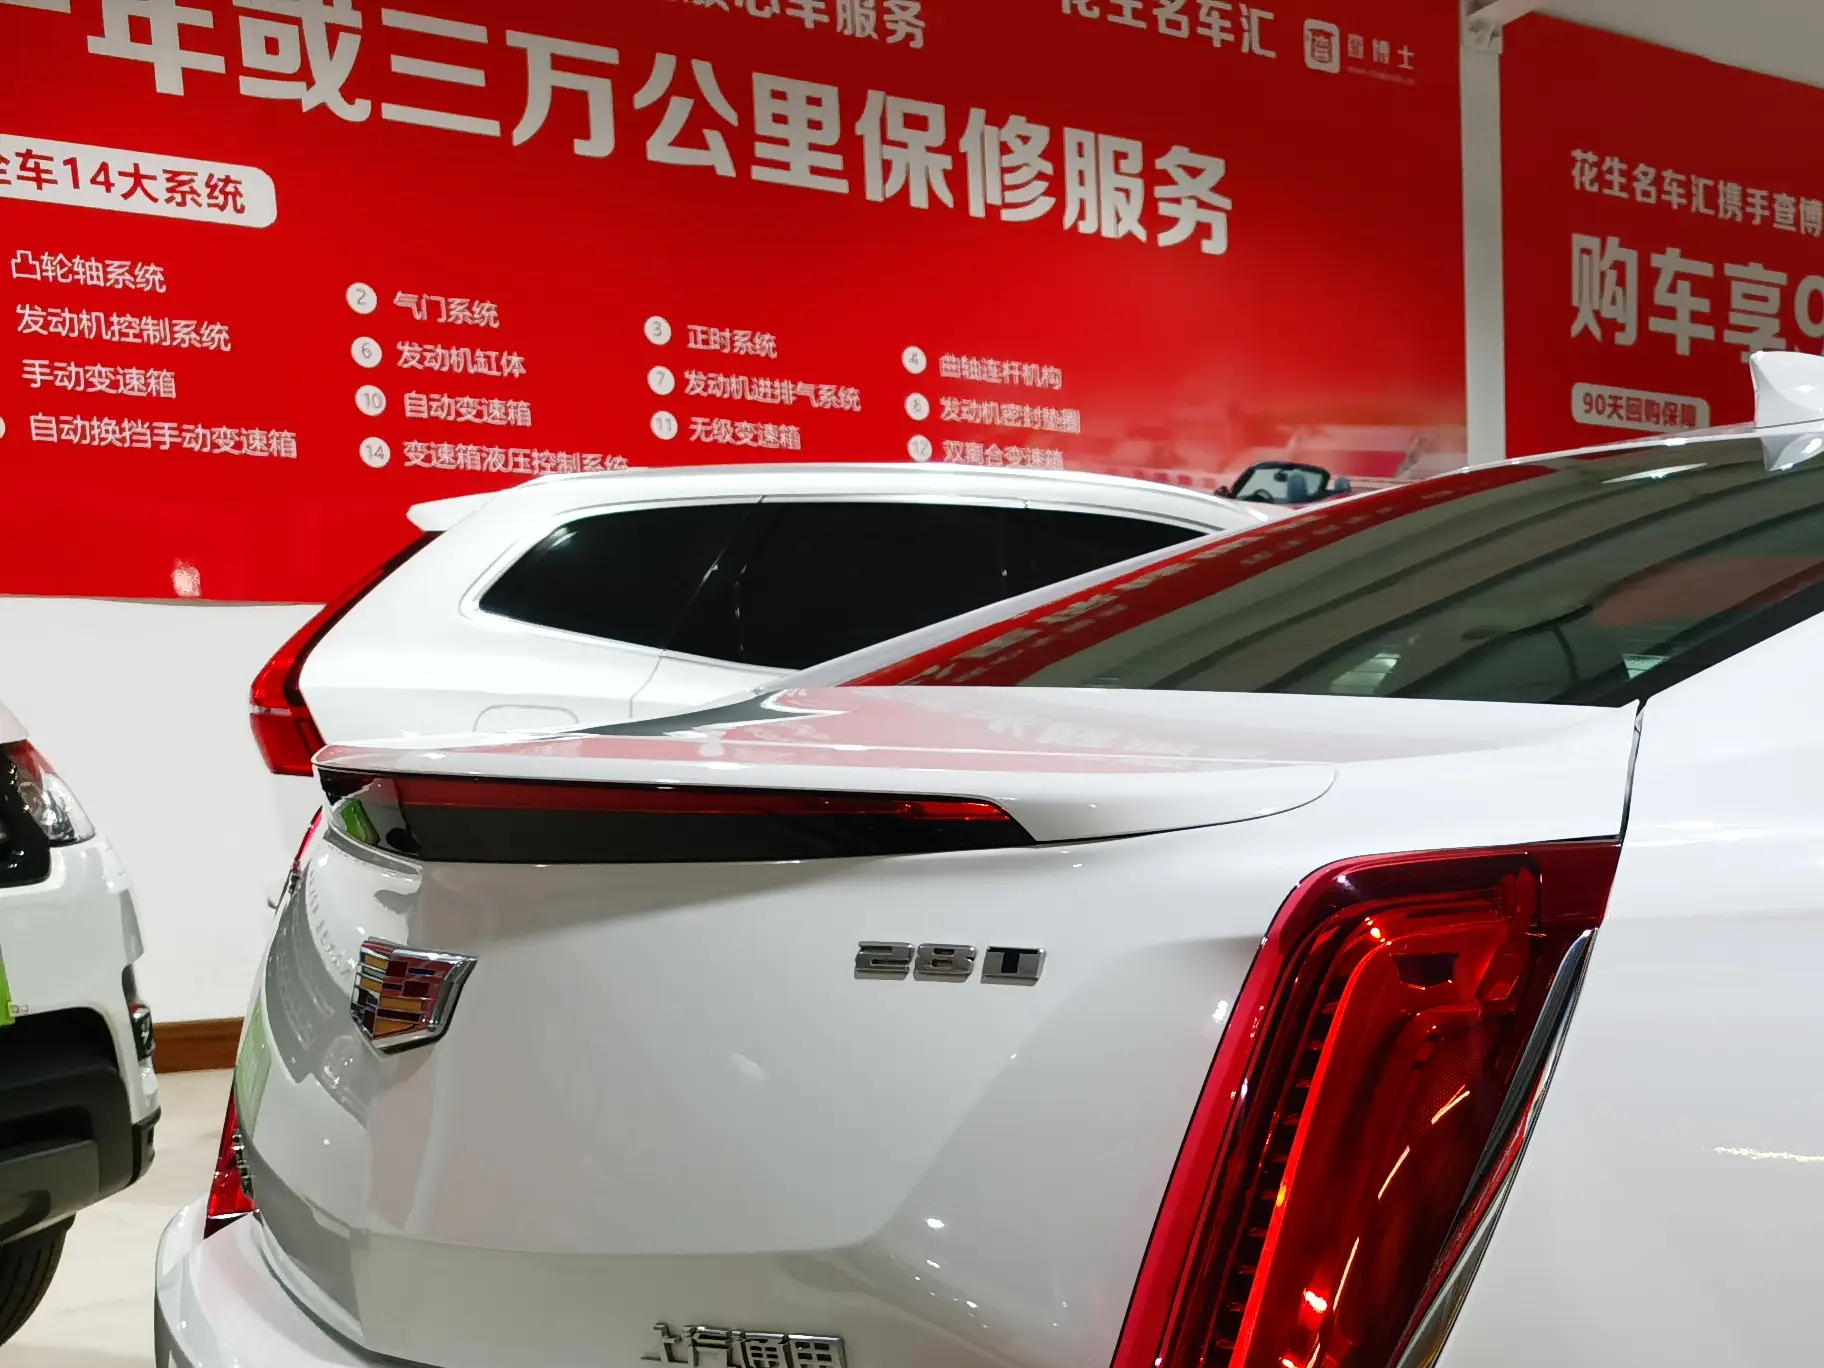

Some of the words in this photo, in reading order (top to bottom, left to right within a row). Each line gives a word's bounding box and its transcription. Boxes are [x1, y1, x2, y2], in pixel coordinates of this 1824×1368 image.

[11, 249, 167, 293] 凸轮轴系统
[16, 303, 232, 352] 发动机控制系统
[357, 288, 367, 305] 2
[393, 290, 500, 329] 气门系统
[361, 342, 373, 359] 6
[396, 340, 527, 378] 发动机缸体
[652, 320, 663, 338] 3
[686, 324, 778, 359] 正时系统
[21, 358, 177, 399] 手动变速箱
[684, 369, 862, 412] 发动机进排气系统
[363, 392, 383, 410] 10
[403, 390, 532, 427] 自动变速箱
[29, 412, 298, 459] 自动换挡手动变速箱
[365, 444, 385, 460] 14
[656, 417, 672, 432] 11
[689, 416, 802, 450] 无级变速箱
